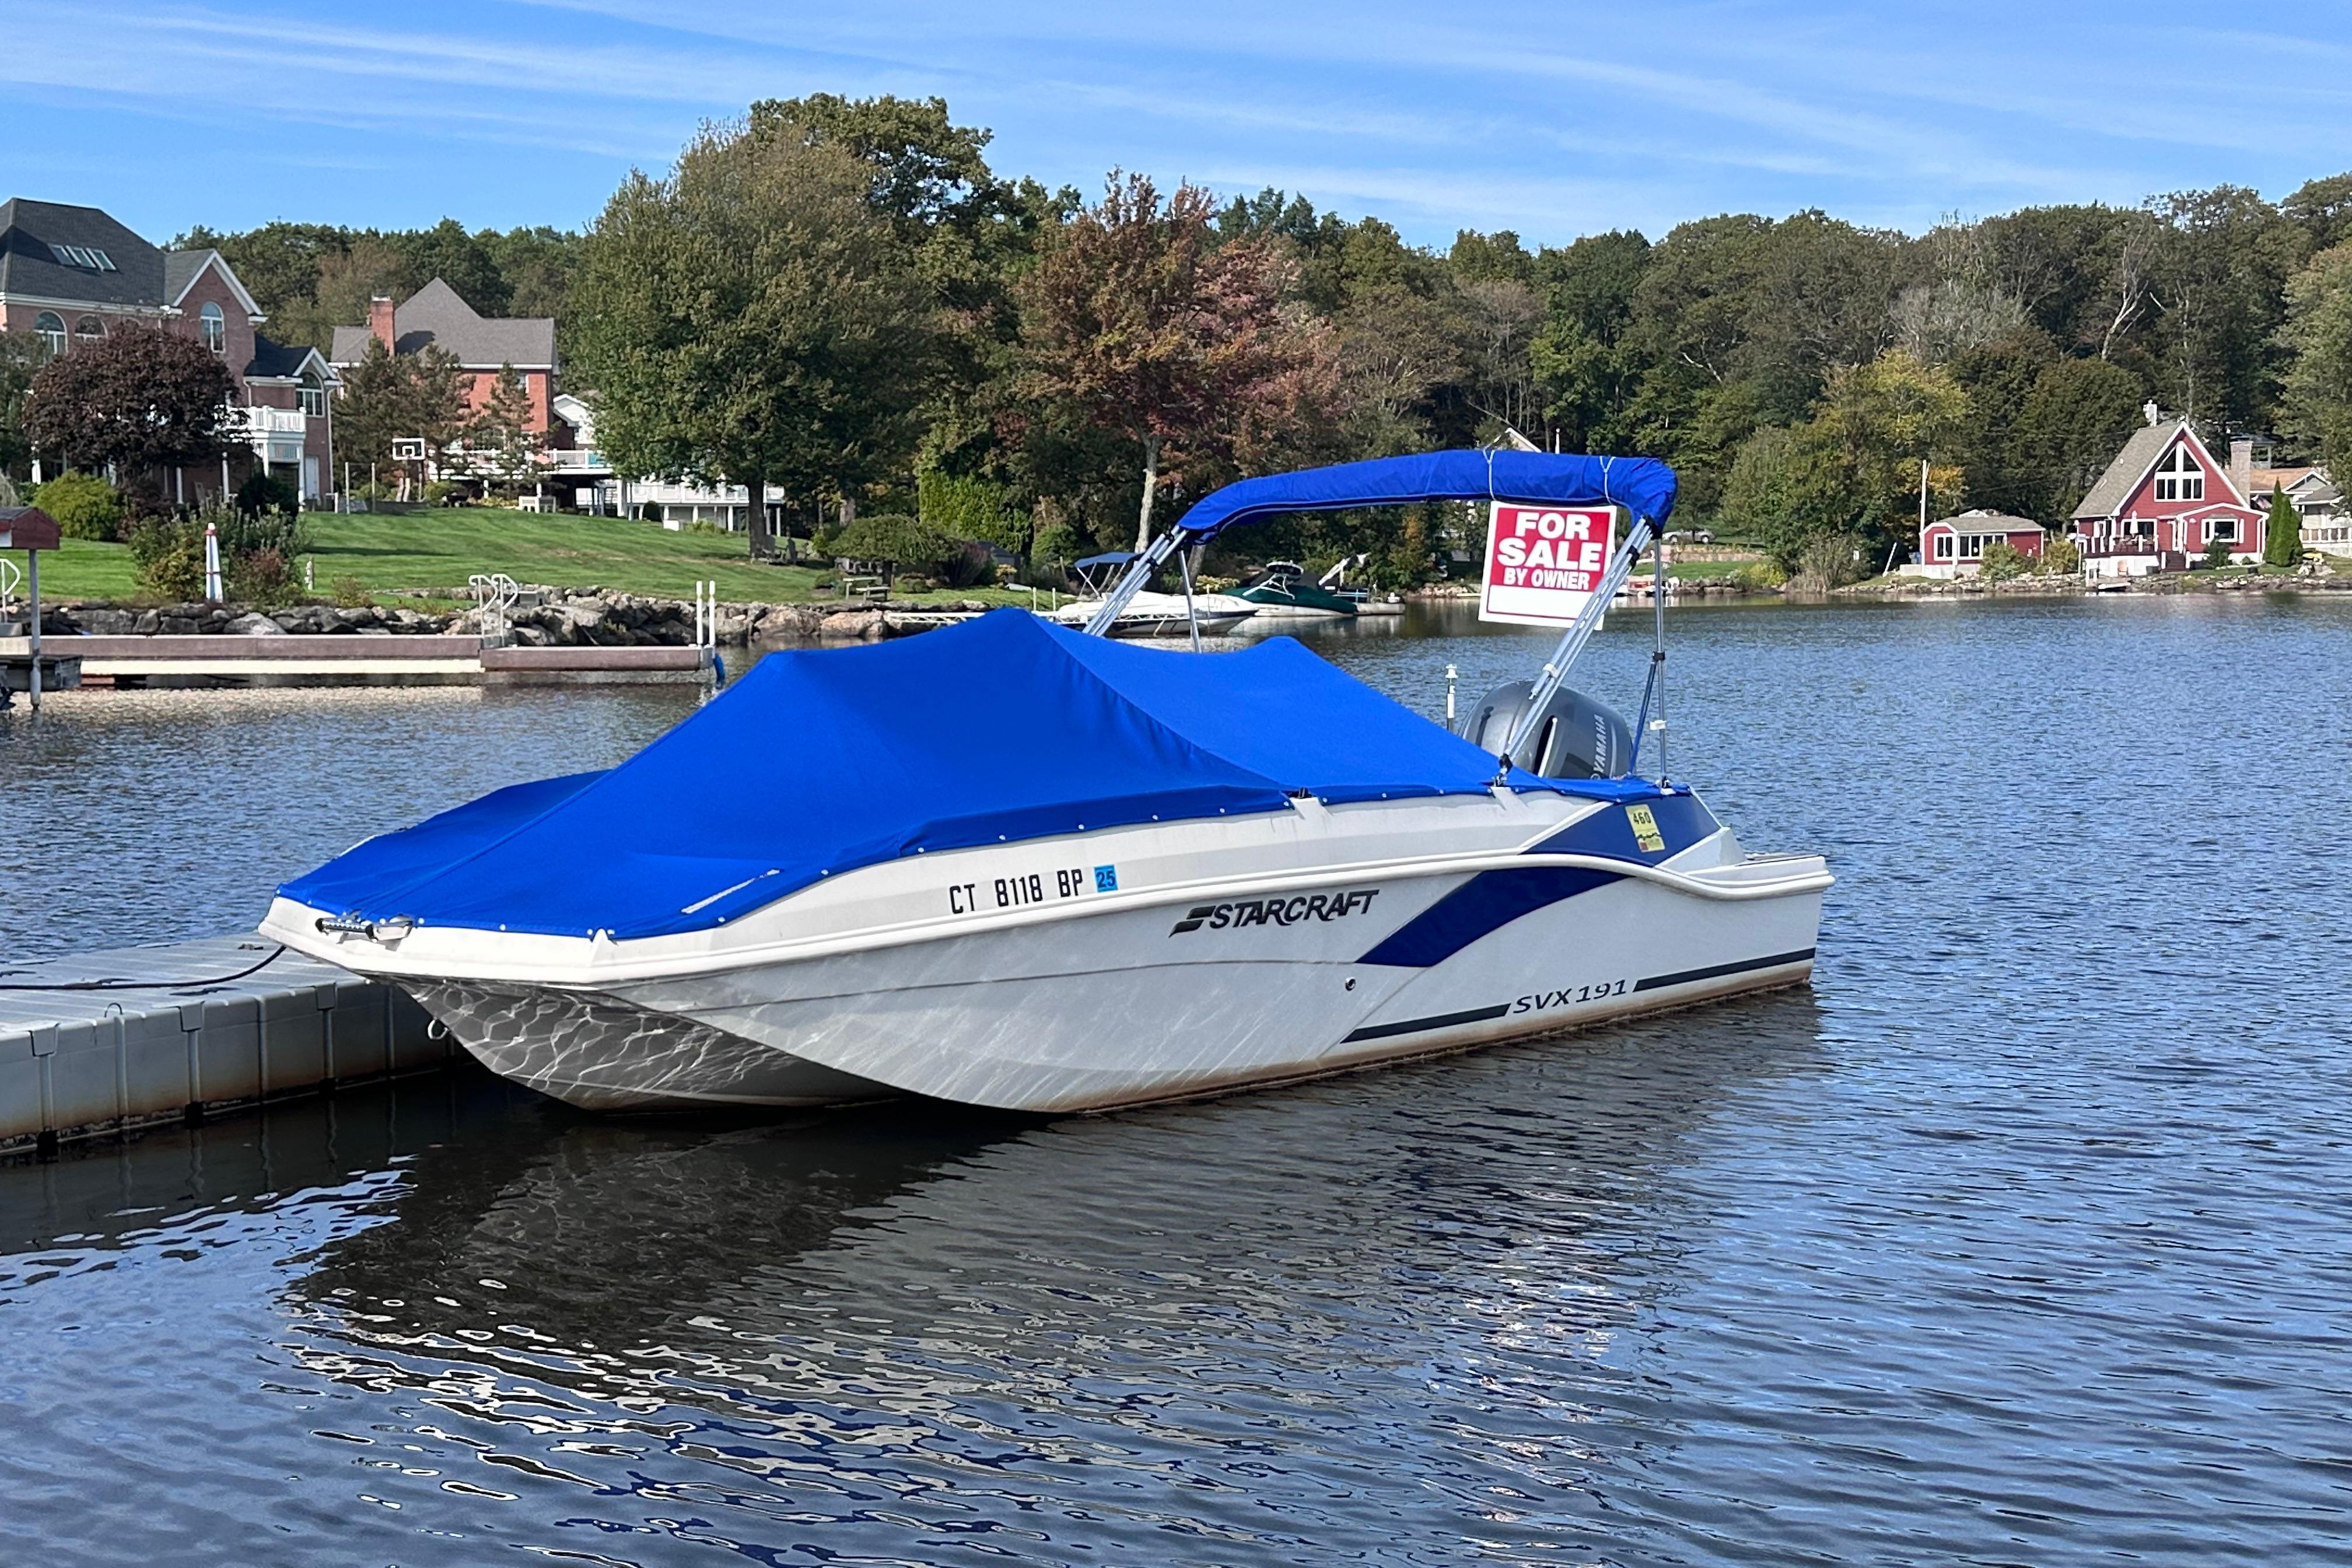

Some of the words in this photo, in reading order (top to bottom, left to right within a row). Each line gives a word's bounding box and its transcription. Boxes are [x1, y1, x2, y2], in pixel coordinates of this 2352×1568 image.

[1515, 512, 1591, 540] FOR
[1497, 537, 1603, 571] SALE
[1503, 567, 1528, 586] BY
[1531, 569, 1590, 590] OWNER
[1593, 714, 1606, 774] YAMAHA
[1633, 811, 1651, 824] 460
[949, 883, 975, 914] CT
[995, 874, 1043, 907] 8118
[1057, 869, 1083, 897] BP
[1096, 871, 1116, 888] 25
[1209, 889, 1380, 929] STARCRAFT
[1513, 988, 1573, 1013] SVX
[1576, 979, 1626, 1003] 191
